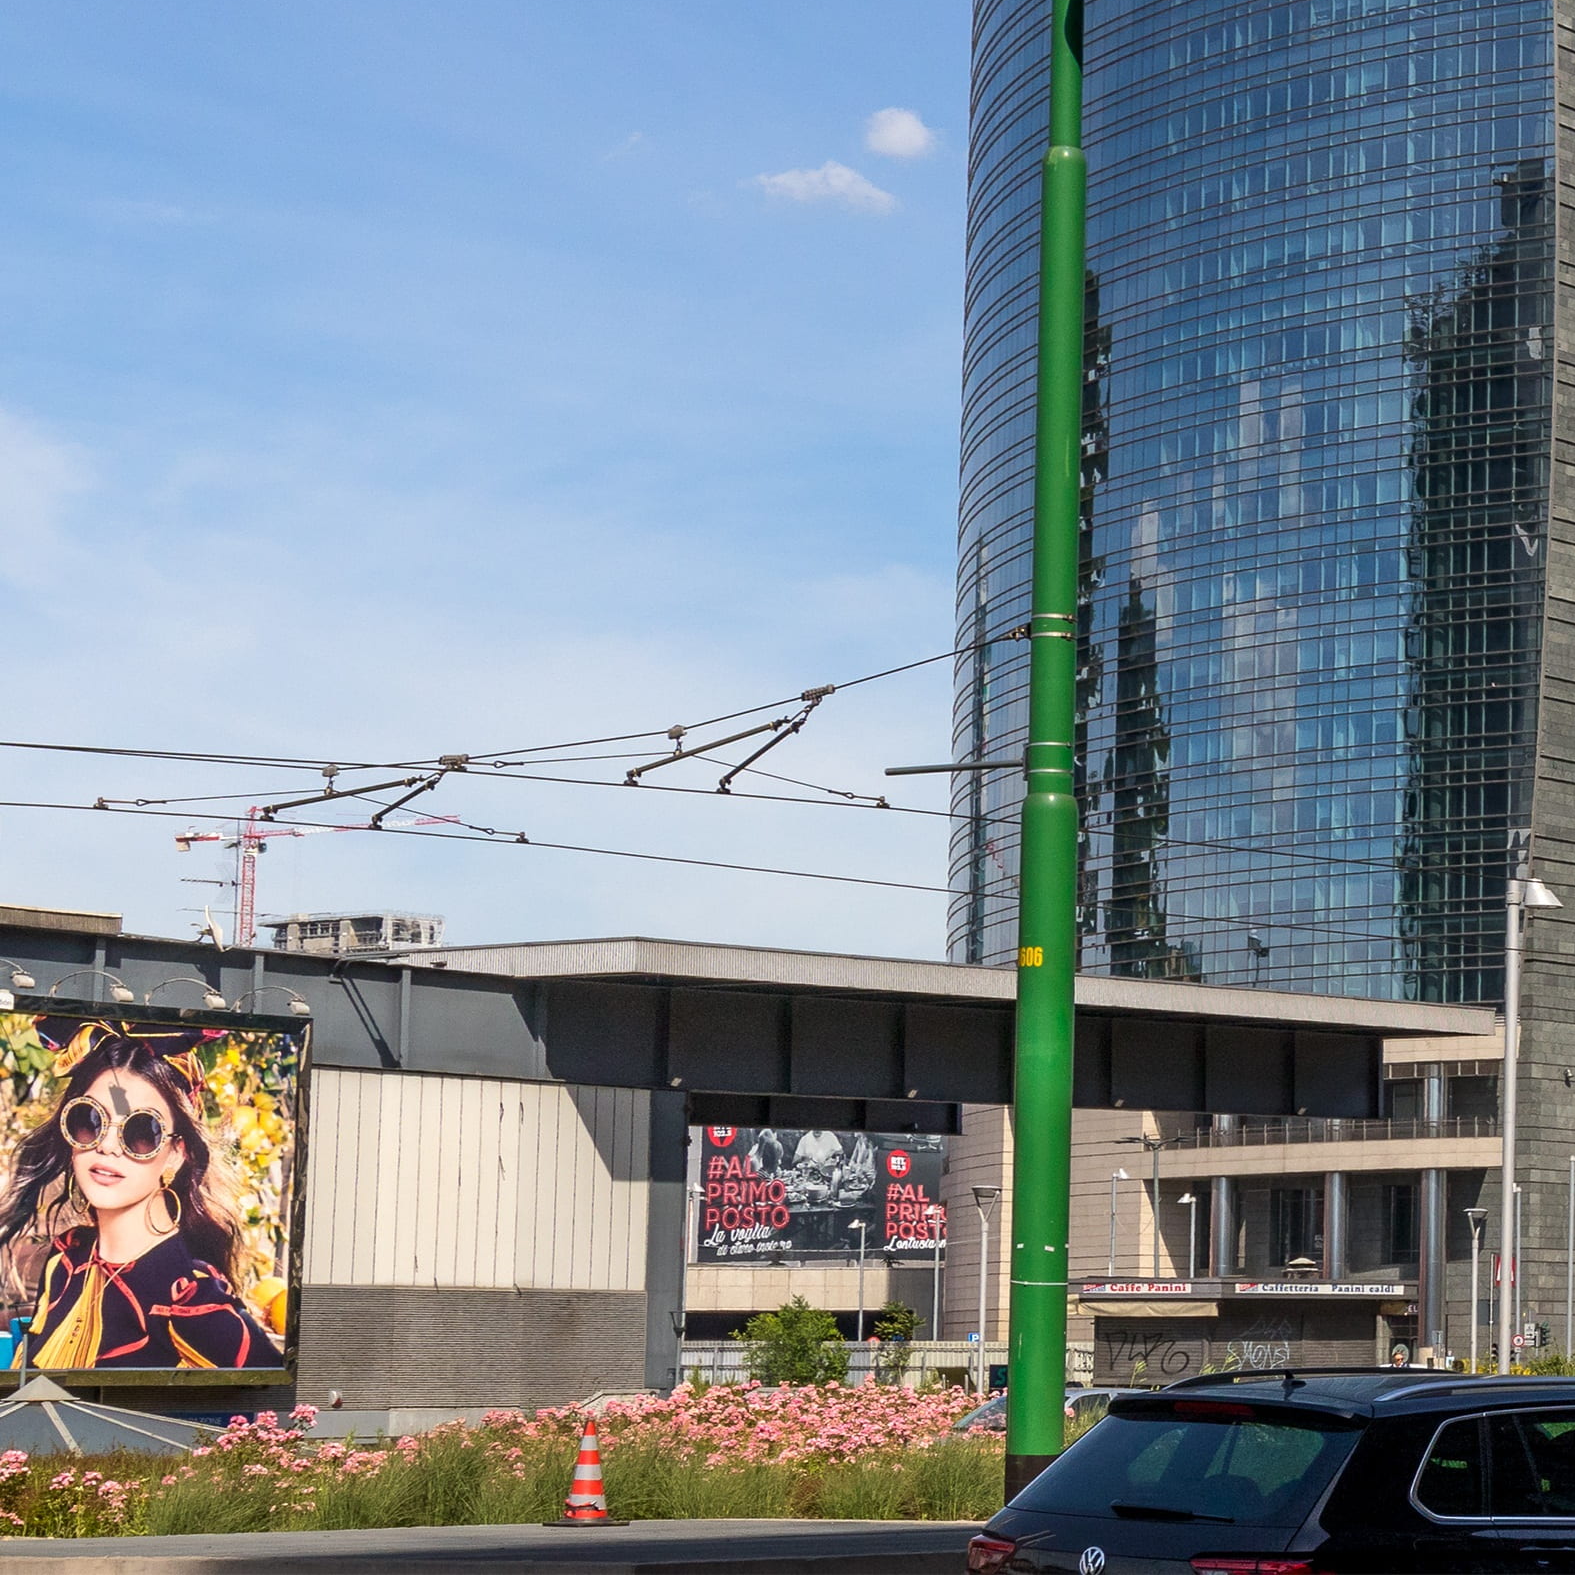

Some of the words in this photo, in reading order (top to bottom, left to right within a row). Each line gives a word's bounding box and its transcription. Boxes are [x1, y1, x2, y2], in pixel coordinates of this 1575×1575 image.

[708, 1155, 759, 1180] #AL
[706, 1180, 786, 1205] PRIMO
[705, 1205, 790, 1230] POSTO
[703, 1223, 726, 1247] La
[730, 1222, 773, 1243] voglia
[1147, 1282, 1188, 1292] Panini
[1261, 1282, 1319, 1293] Caffetteria
[1331, 1283, 1365, 1293] Panini
[1368, 1284, 1395, 1294] caldi
